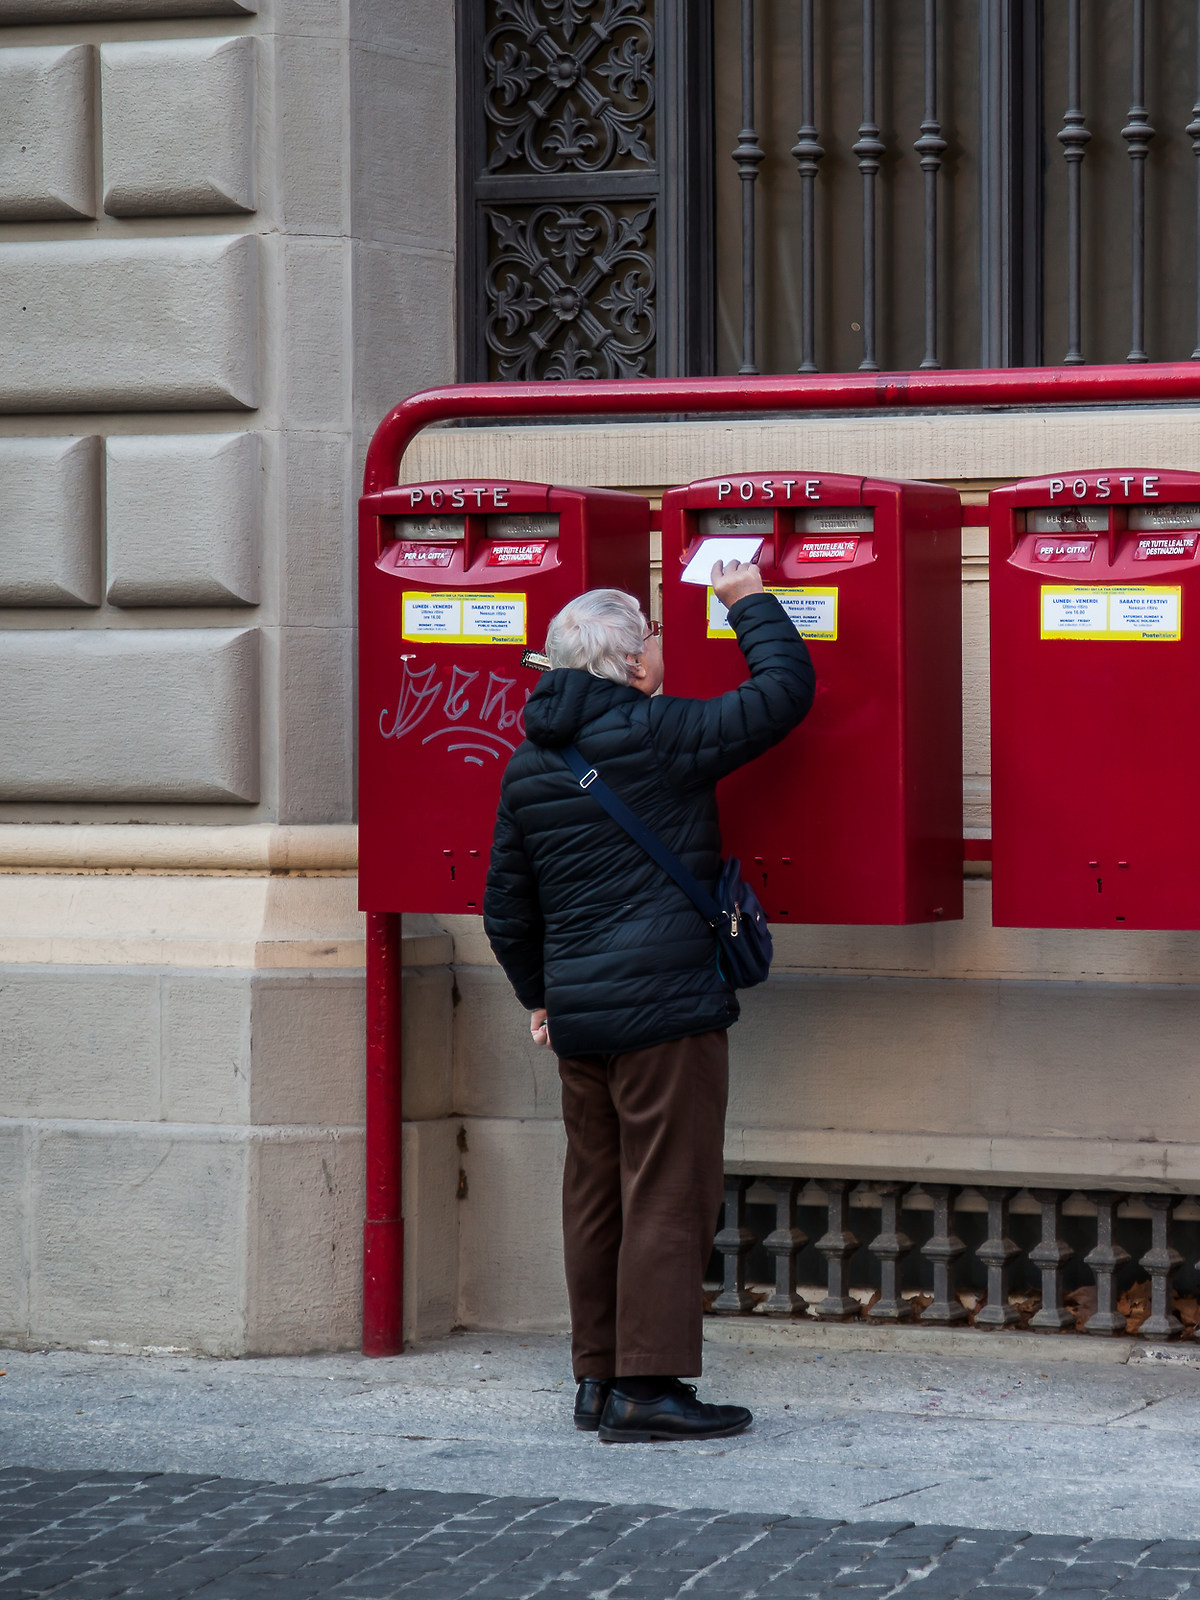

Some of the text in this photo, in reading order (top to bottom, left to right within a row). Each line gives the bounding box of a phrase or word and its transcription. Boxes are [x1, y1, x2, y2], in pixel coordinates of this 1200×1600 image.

[718, 480, 821, 501] POSTE
[1049, 476, 1160, 499] POSTE
[410, 487, 510, 508] POSTE
[802, 543, 814, 551] PER
[813, 543, 830, 551] TUTTE
[837, 542, 855, 550] ALTRE
[1139, 540, 1151, 548] PER
[1150, 540, 1168, 548] TUTTE
[1176, 539, 1194, 547] ALTRE
[527, 545, 544, 553] ALTRE
[1055, 546, 1065, 554] LA
[1146, 547, 1185, 555] DESTINAZIONI
[404, 552, 416, 560] PER
[418, 552, 427, 560] LA
[498, 553, 533, 561] DESTINAZIONI
[808, 550, 845, 558] DESTINAZIONI
